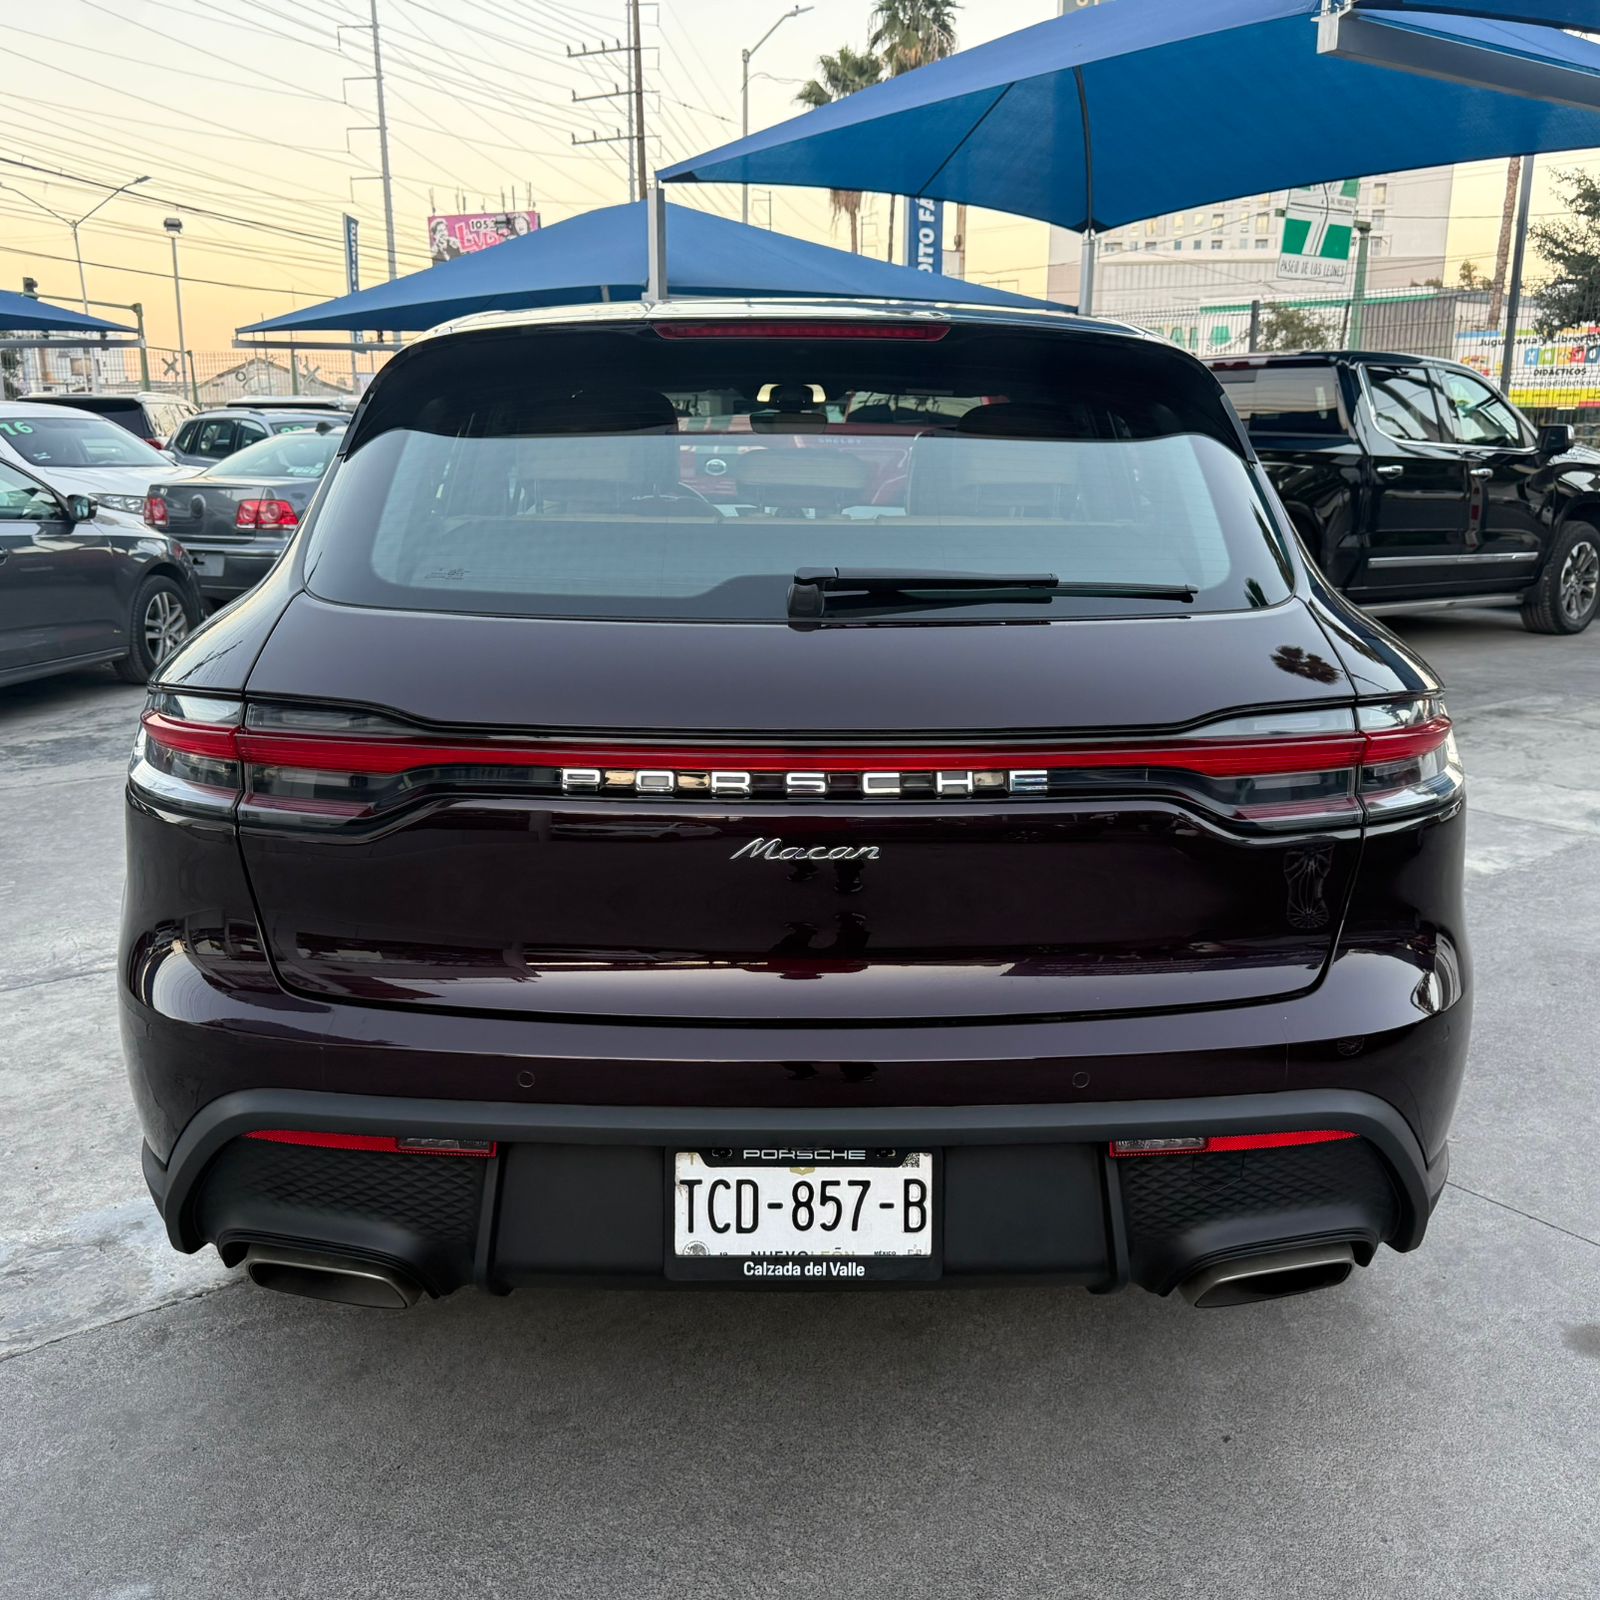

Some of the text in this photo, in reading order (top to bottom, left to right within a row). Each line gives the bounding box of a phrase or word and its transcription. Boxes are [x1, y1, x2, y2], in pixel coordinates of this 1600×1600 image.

[1280, 260, 1300, 274] PASEO
[1310, 262, 1322, 276] LOS
[1323, 264, 1345, 277] LEONES
[561, 768, 1048, 795] PORSCHE
[729, 837, 880, 860] Macan
[743, 1149, 866, 1160] PORSCHE
[679, 1179, 927, 1234] TCD-857-B
[743, 1261, 866, 1277] Calzada del Valle
